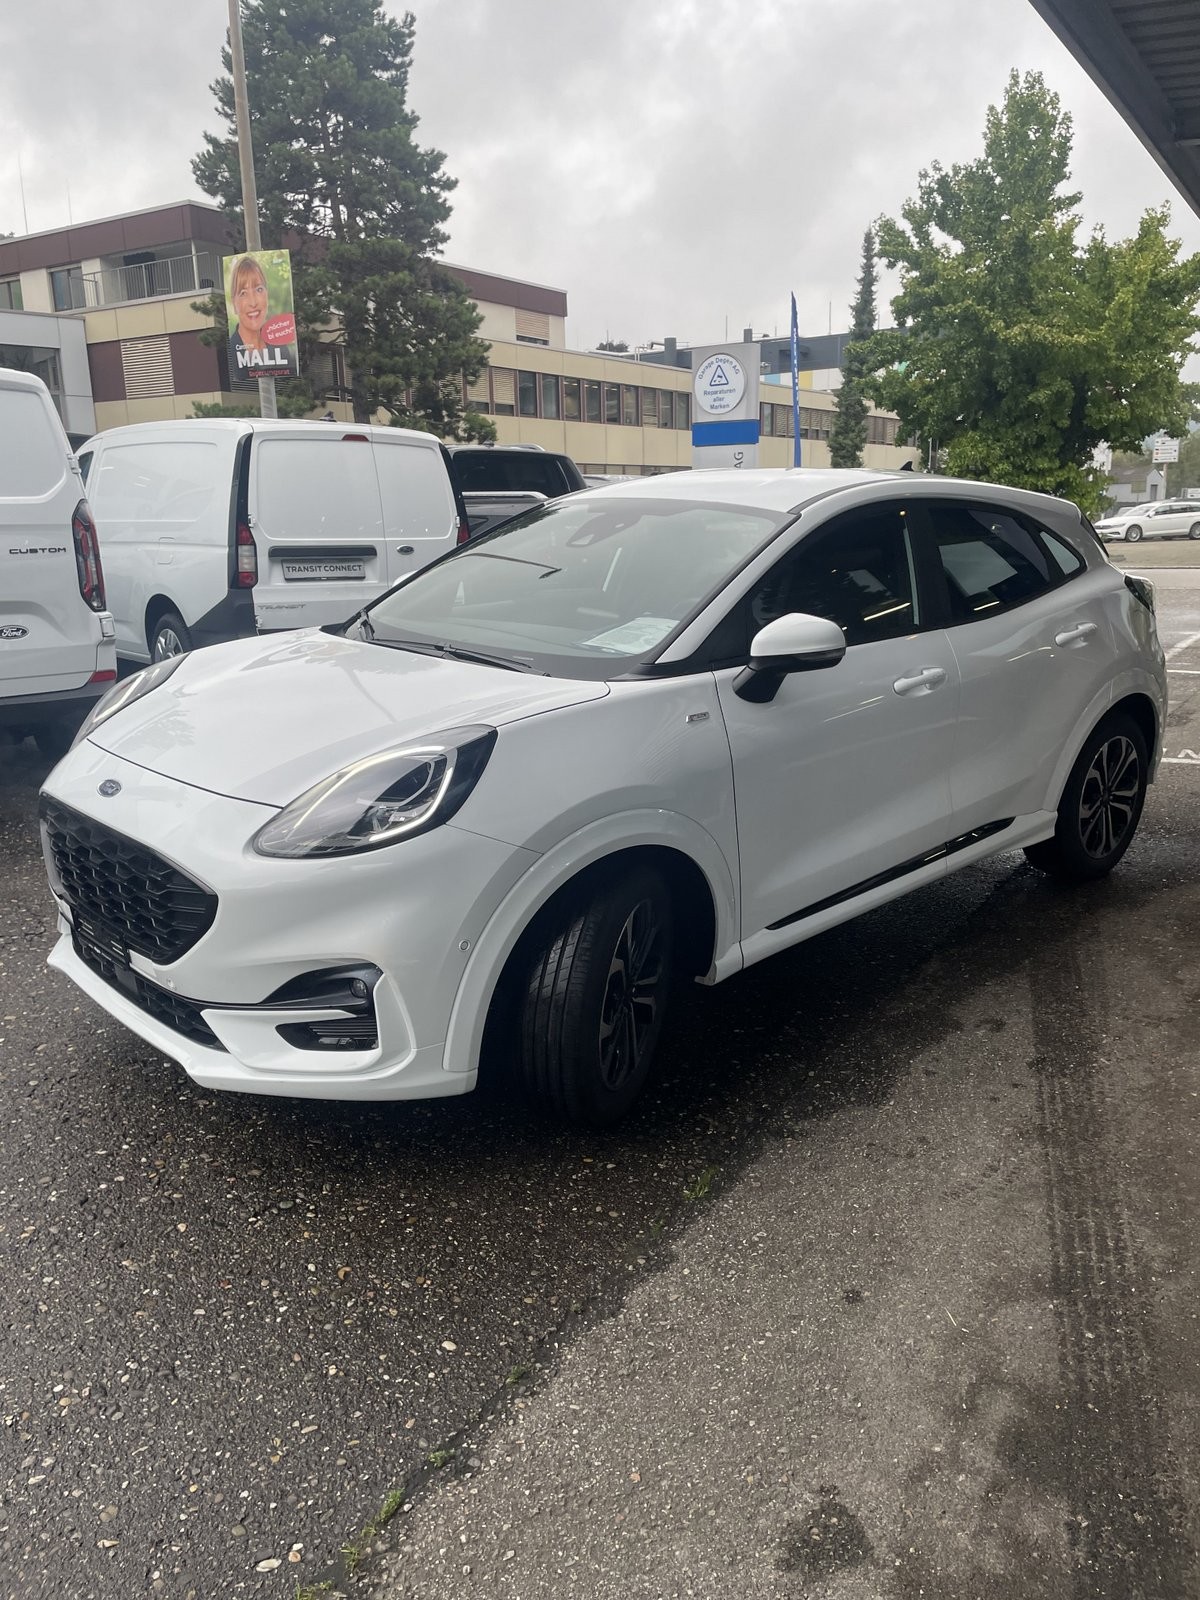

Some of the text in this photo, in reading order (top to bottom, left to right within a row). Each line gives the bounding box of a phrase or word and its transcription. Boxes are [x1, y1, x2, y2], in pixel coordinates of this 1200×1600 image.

[236, 347, 288, 369] MALL
[698, 357, 741, 380] Garage Degen AG
[703, 388, 737, 397] Reparaturen
[709, 403, 730, 411] Marken
[8, 547, 67, 555] CUSTOM
[285, 564, 363, 573] TRANSIT CONNECT
[1, 628, 23, 637] Ford
